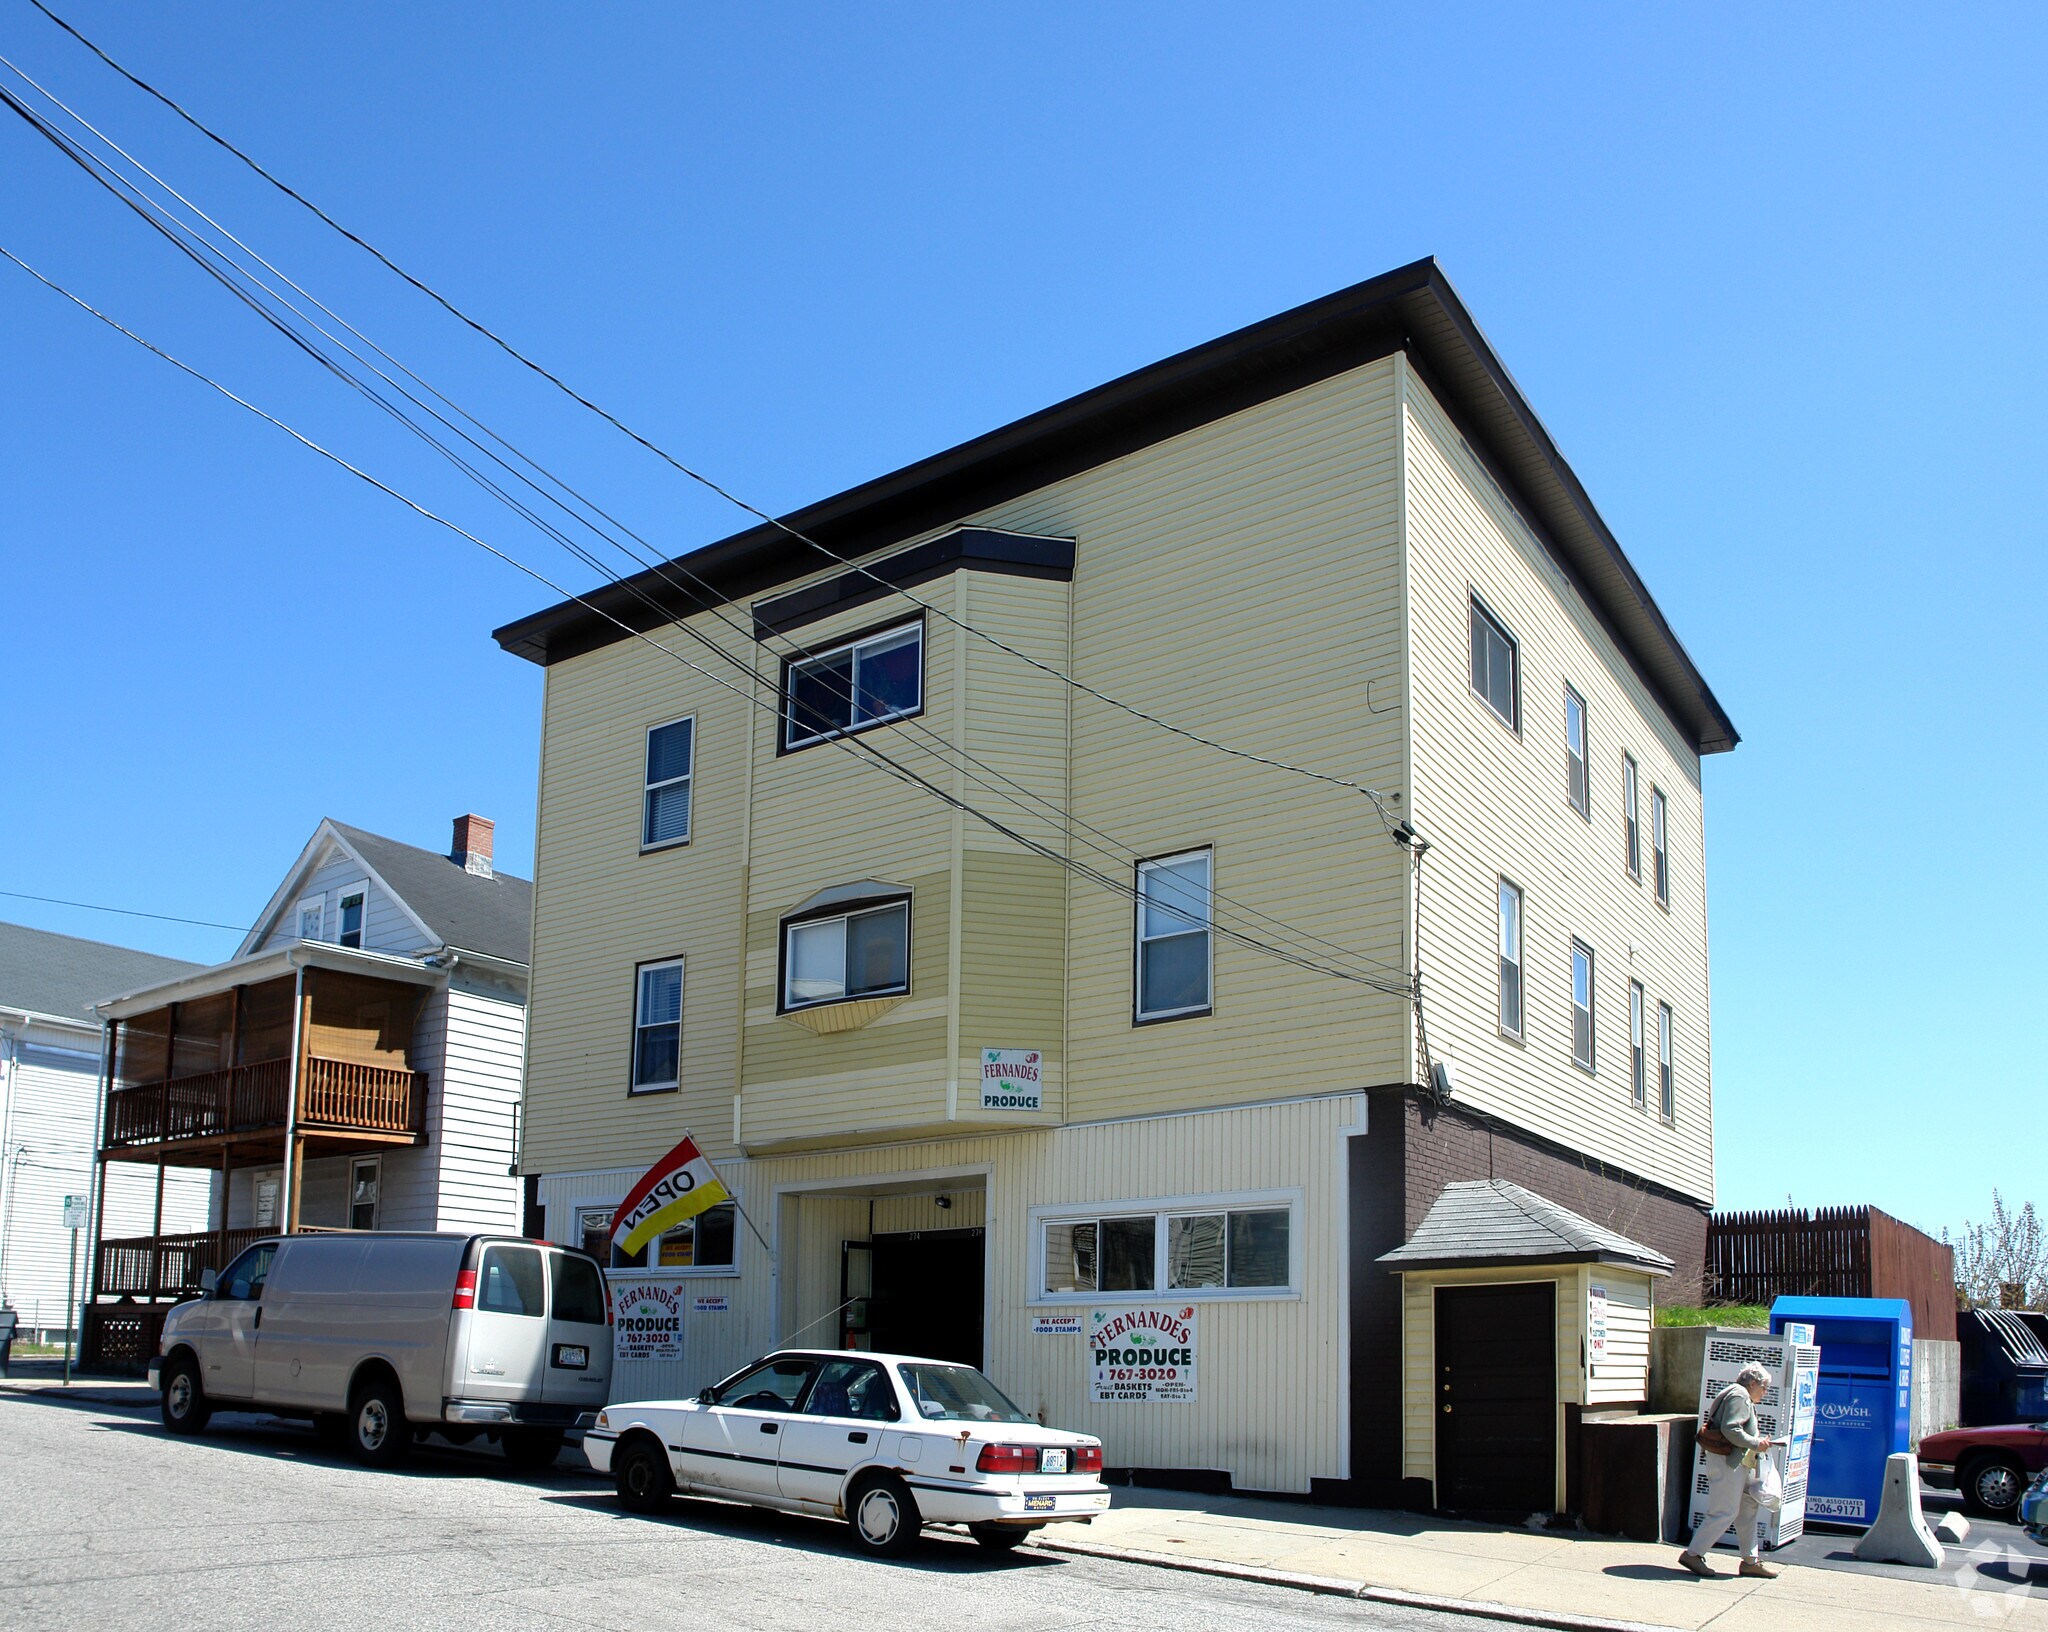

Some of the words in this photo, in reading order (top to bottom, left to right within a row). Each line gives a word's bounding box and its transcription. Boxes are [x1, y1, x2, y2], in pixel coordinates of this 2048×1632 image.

[984, 1063, 1039, 1082] FERNANDES
[984, 1095, 1038, 1108] PRODUCE
[909, 1232, 920, 1240] 274
[618, 1286, 680, 1315] FERNANDES
[617, 1317, 680, 1332] PRODUCE
[1095, 1311, 1191, 1348] FERNANDES
[627, 1333, 670, 1343] 767-3020
[1095, 1348, 1192, 1366] PRODUCE
[1108, 1368, 1177, 1381] 767-3020
[1094, 1382, 1114, 1391] Fruit
[1114, 1383, 1152, 1391] BASKETS
[1100, 1392, 1115, 1400] EBT
[1117, 1391, 1147, 1400] CARDS
[1826, 1498, 1864, 1507] ASSOCIATES
